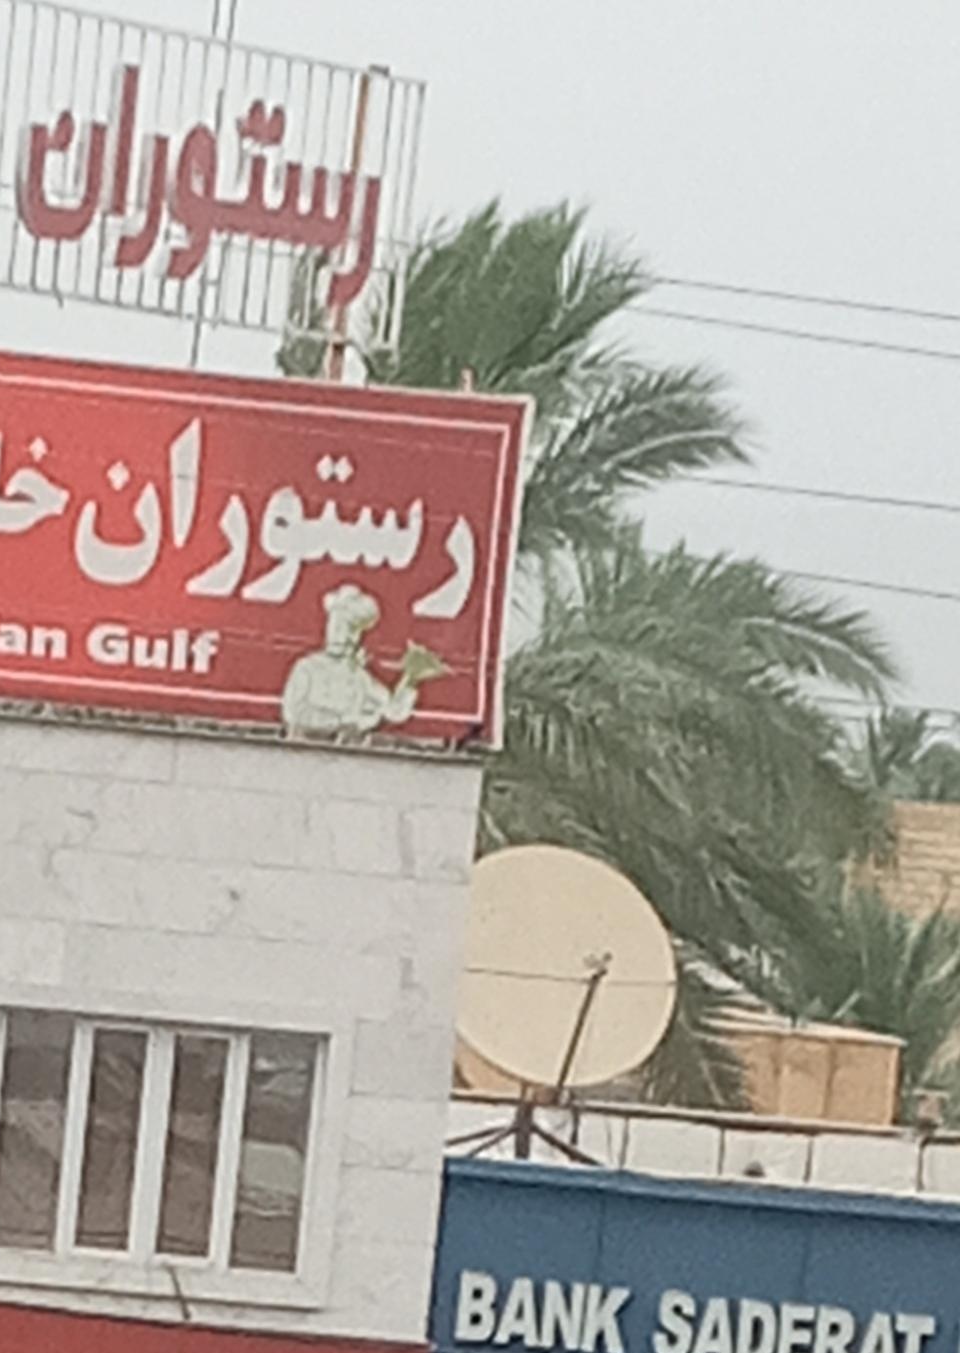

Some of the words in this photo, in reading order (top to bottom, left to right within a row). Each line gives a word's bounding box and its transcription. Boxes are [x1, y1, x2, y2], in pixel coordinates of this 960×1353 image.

[16, 64, 381, 308] رستوران
[74, 418, 475, 618] رستوران
[87, 622, 220, 674] Gulf
